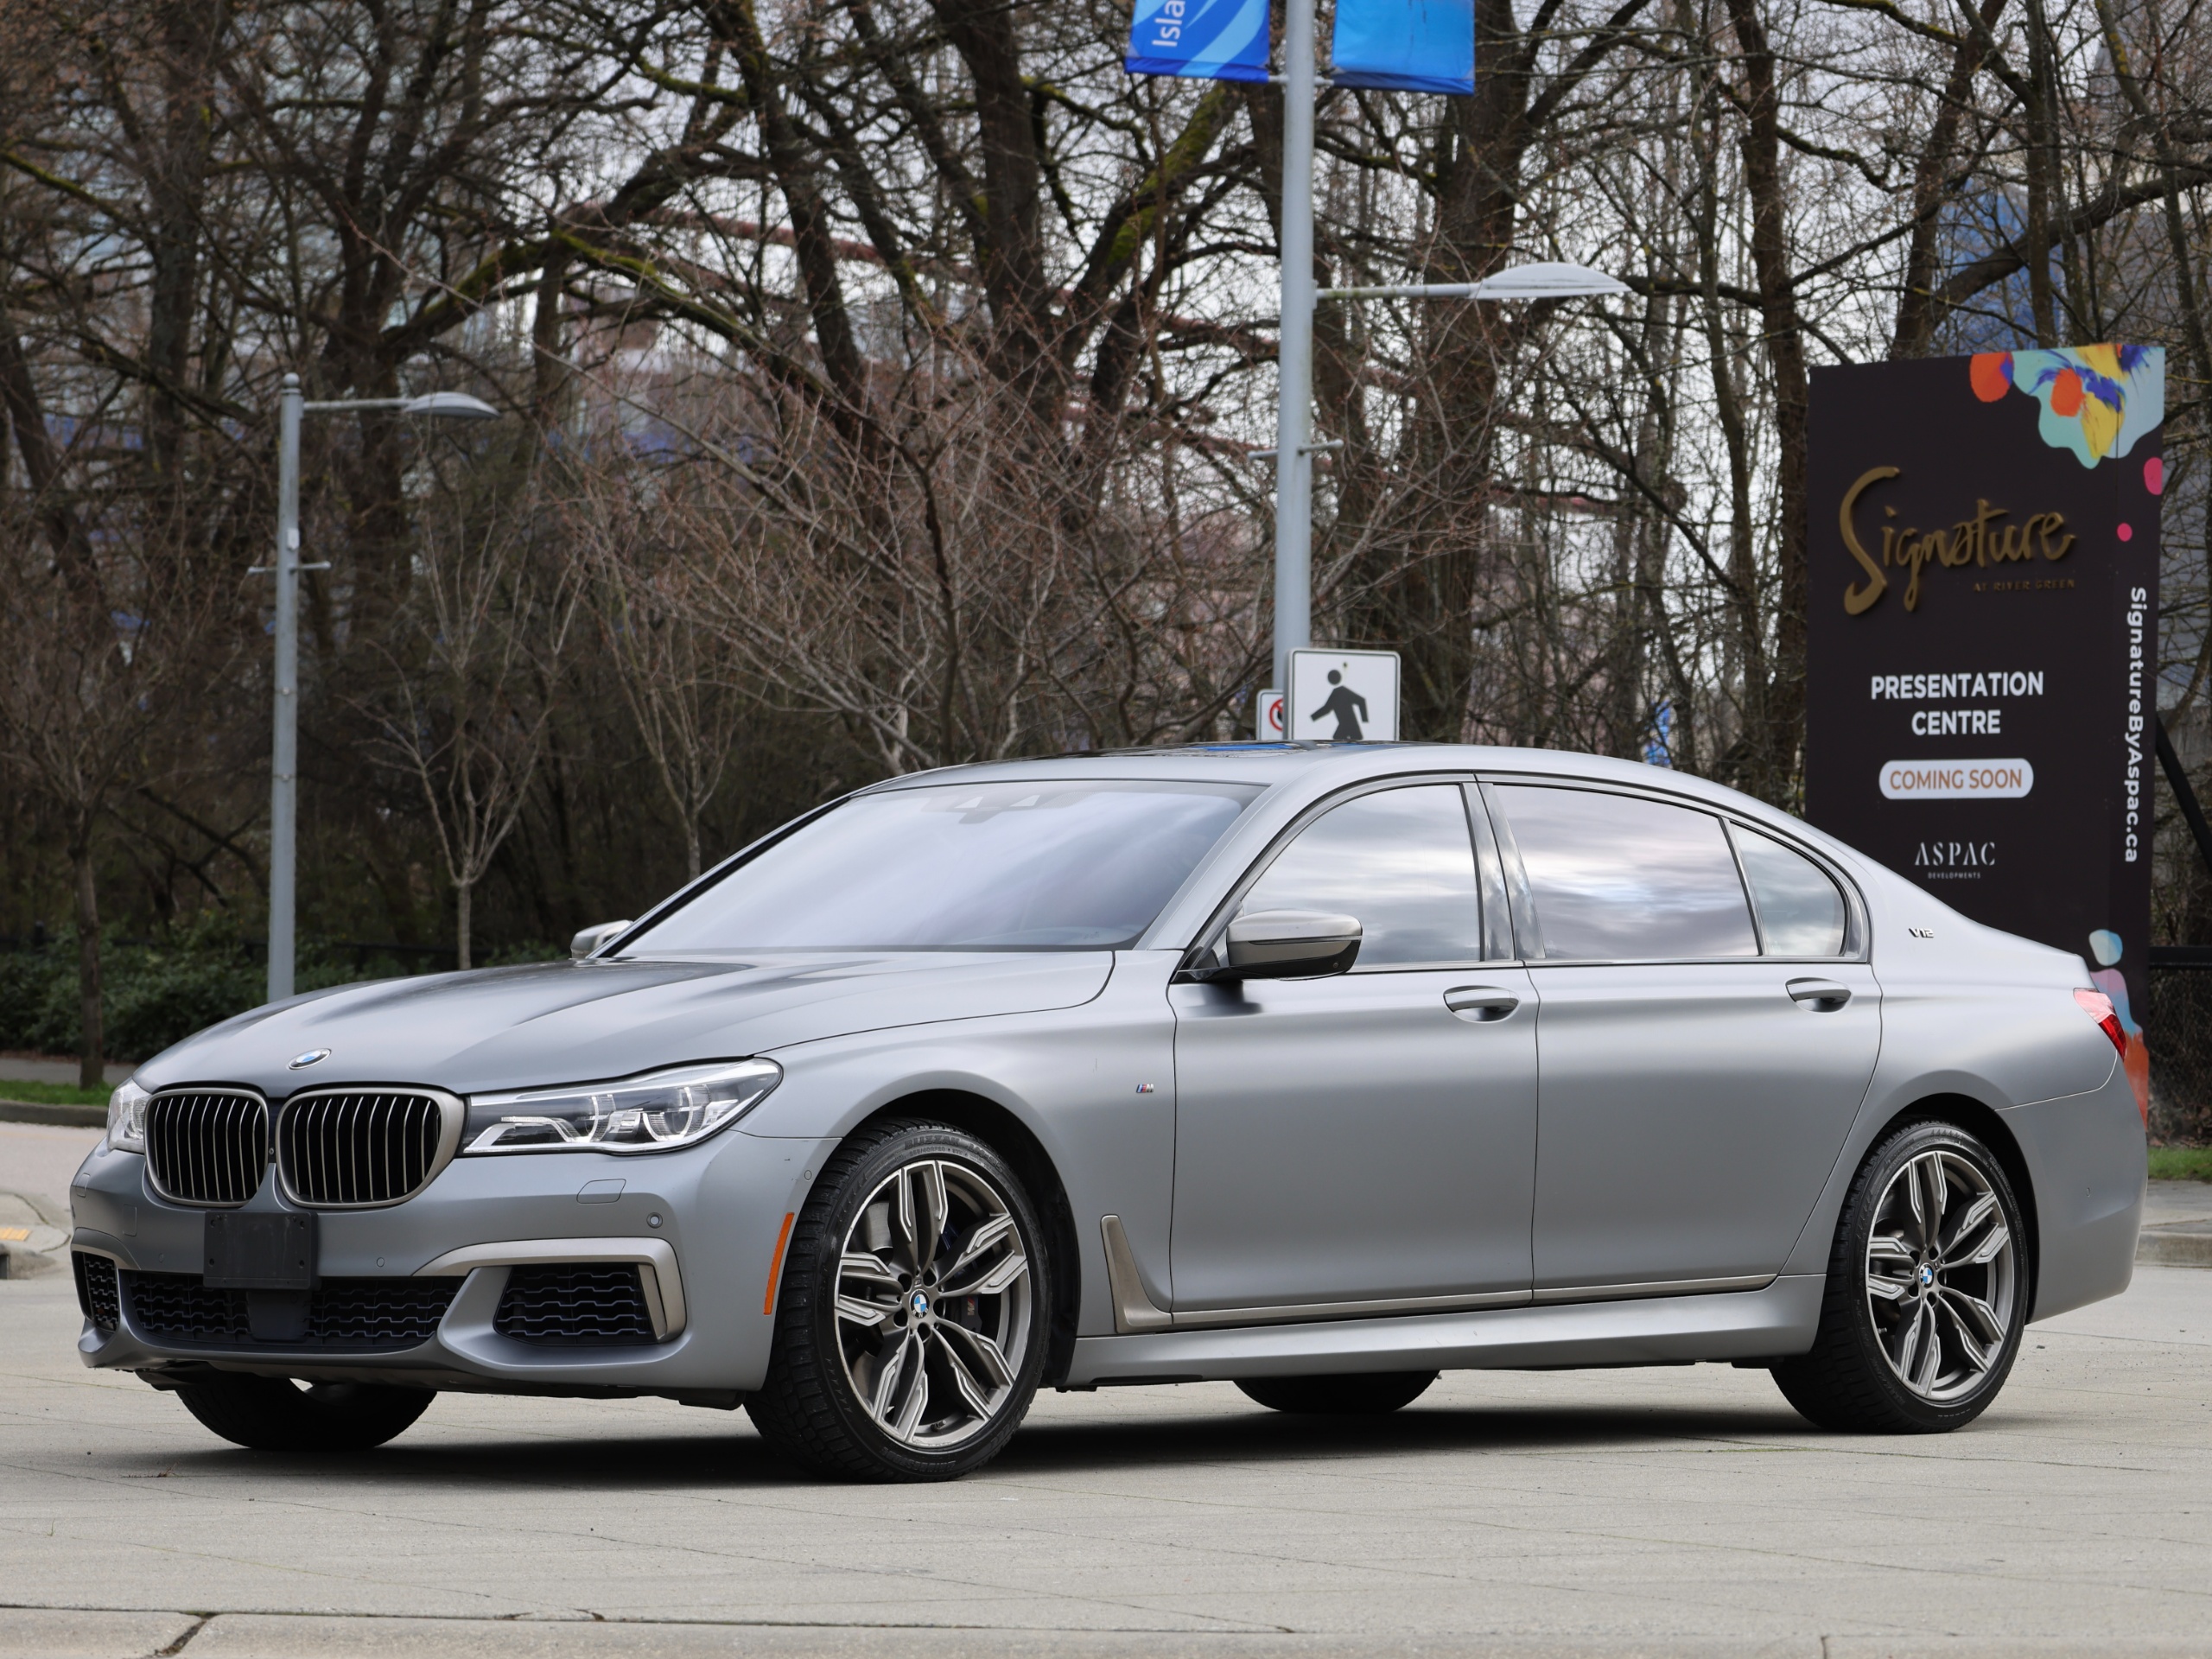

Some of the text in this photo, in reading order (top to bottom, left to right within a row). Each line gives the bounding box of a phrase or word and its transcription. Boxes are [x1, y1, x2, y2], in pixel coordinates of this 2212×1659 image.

[1840, 467, 2076, 615] Signature
[1871, 671, 2044, 700] PRESENTATION
[1911, 709, 2001, 735] CENTRE
[2124, 586, 2147, 862] SignatureByAspac.ca
[1890, 768, 2023, 790] COMING SOON
[1914, 842, 1995, 866] ASPAC
[1927, 871, 1981, 880] DEVELOPMENTS
